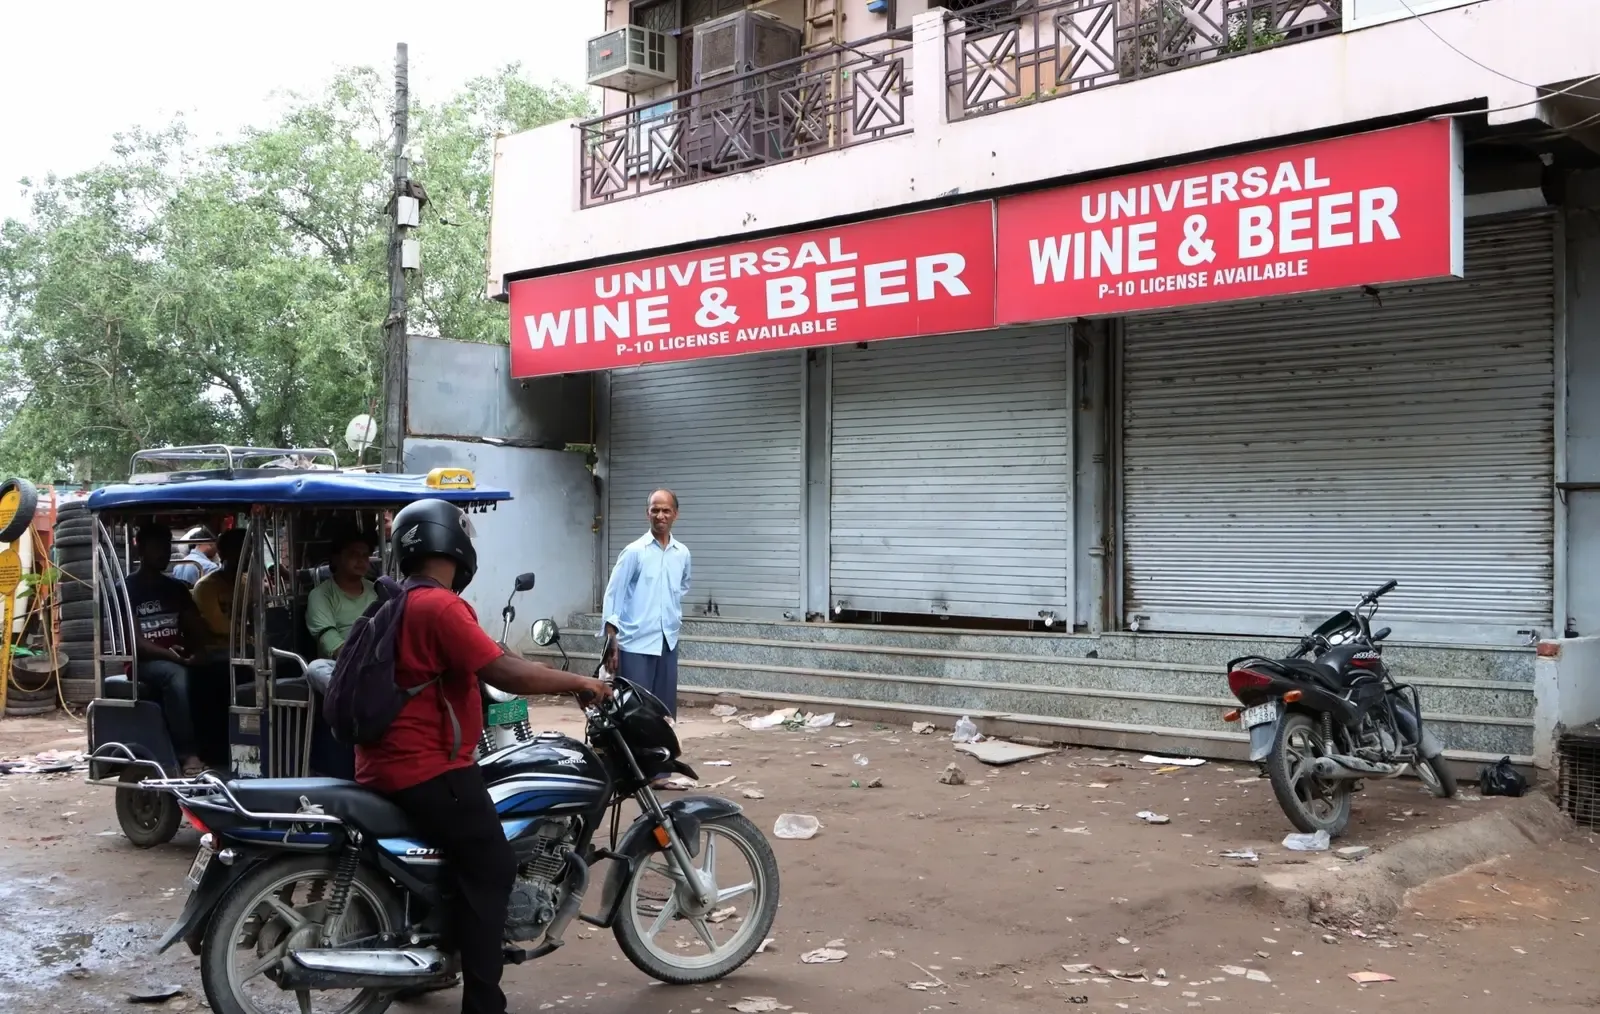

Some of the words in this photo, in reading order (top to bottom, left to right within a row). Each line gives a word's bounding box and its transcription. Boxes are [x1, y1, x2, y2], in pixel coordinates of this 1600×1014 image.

[1081, 157, 1331, 224] UNIVERSAL
[594, 236, 858, 299] UNIVERSAL
[1028, 220, 1158, 286] WINE
[1177, 213, 1217, 267] &
[1238, 186, 1401, 260] BEER
[523, 294, 671, 350] WINE
[694, 286, 741, 328] &
[765, 252, 972, 320] BEER
[1098, 280, 1135, 299] P-10
[1140, 271, 1208, 294] LICENSE
[1213, 258, 1308, 286] AVAILABLE
[616, 340, 654, 356] P-10
[659, 330, 730, 352] LICENSE
[735, 317, 838, 342] AVAILABLE
